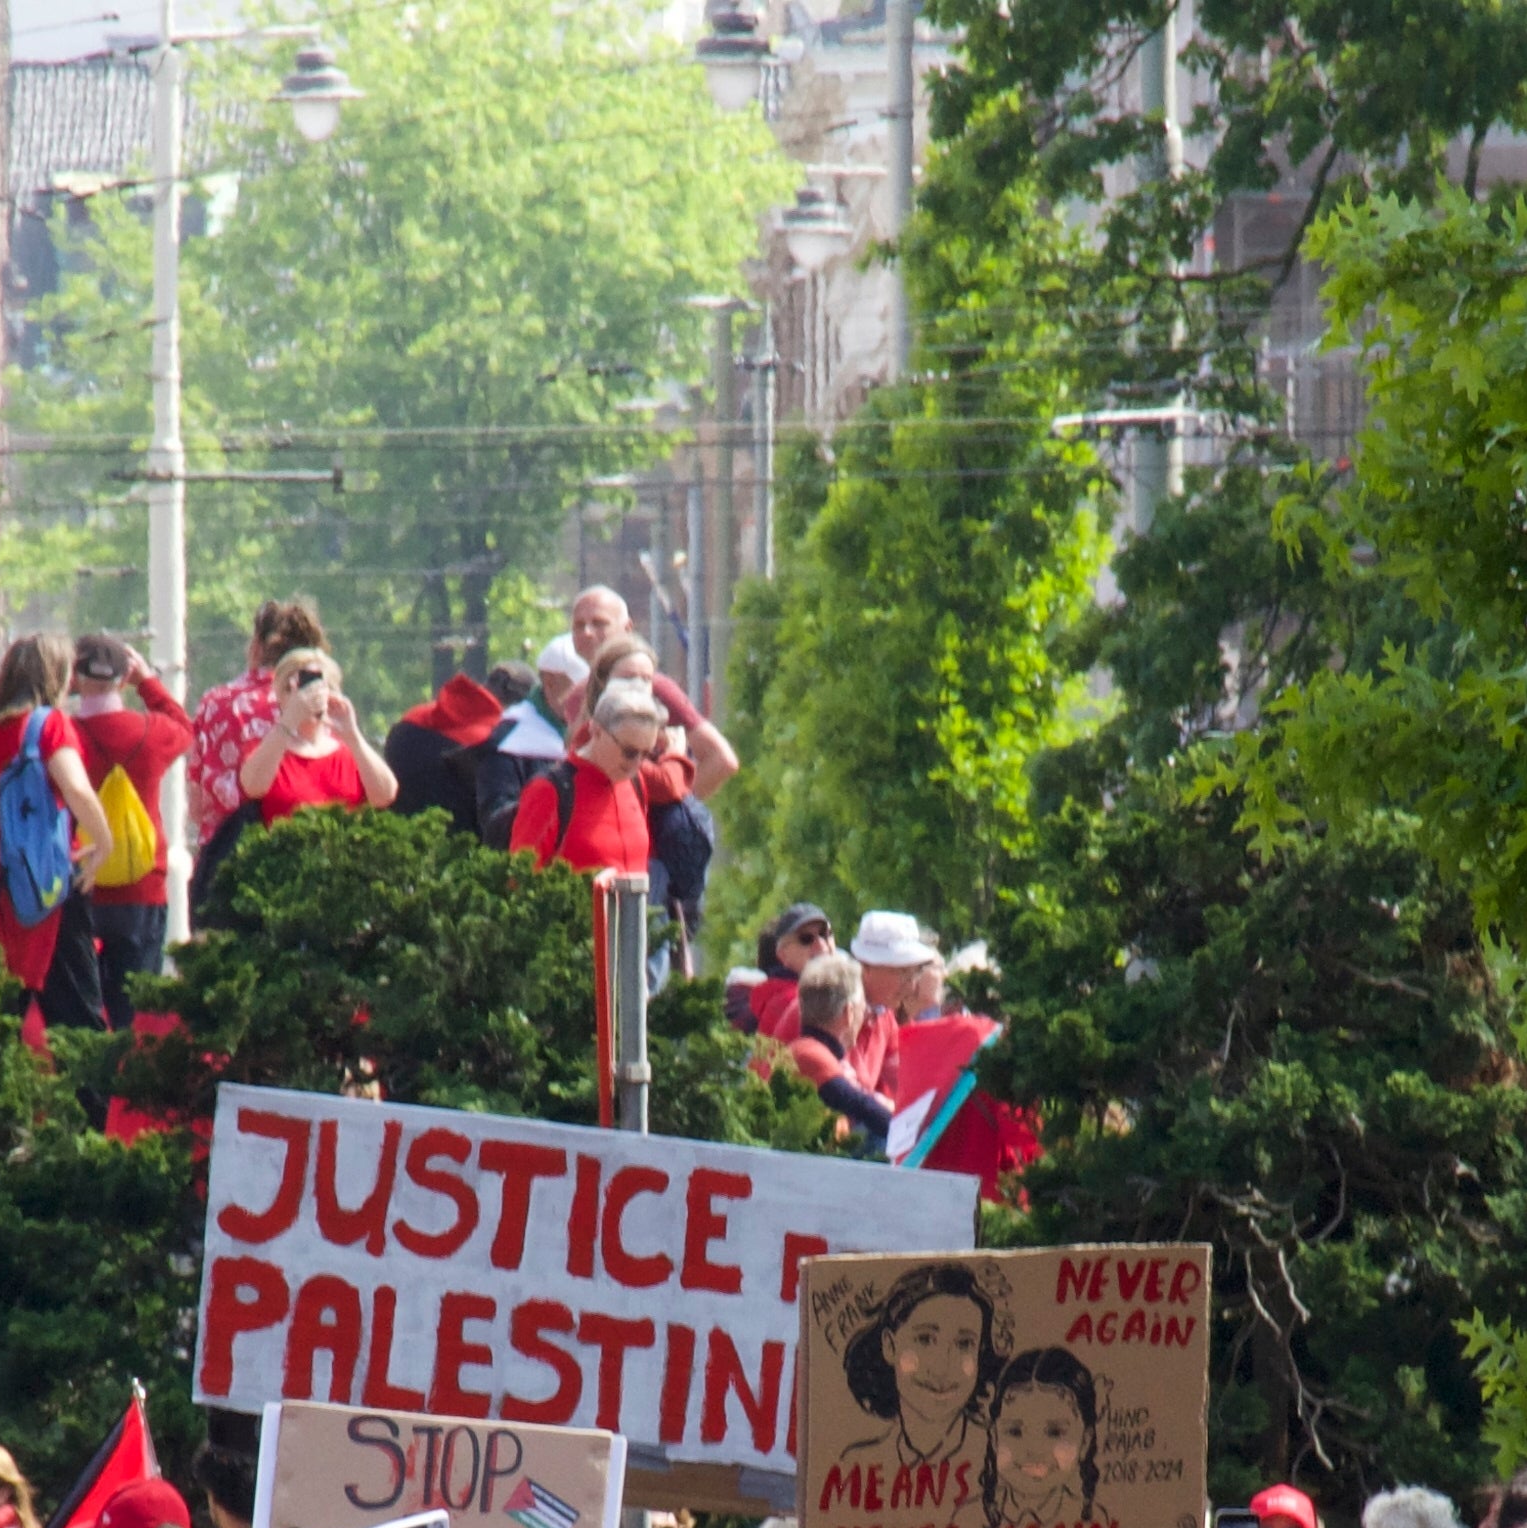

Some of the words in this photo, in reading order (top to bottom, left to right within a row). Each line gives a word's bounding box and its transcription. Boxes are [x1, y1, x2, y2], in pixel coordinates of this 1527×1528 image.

[217, 1107, 754, 1295] JUSTICE
[1056, 1256, 1203, 1306] NEVER
[200, 1254, 798, 1461] PALESTIN
[345, 1415, 523, 1514] STOP
[819, 1460, 971, 1511] MEANS
